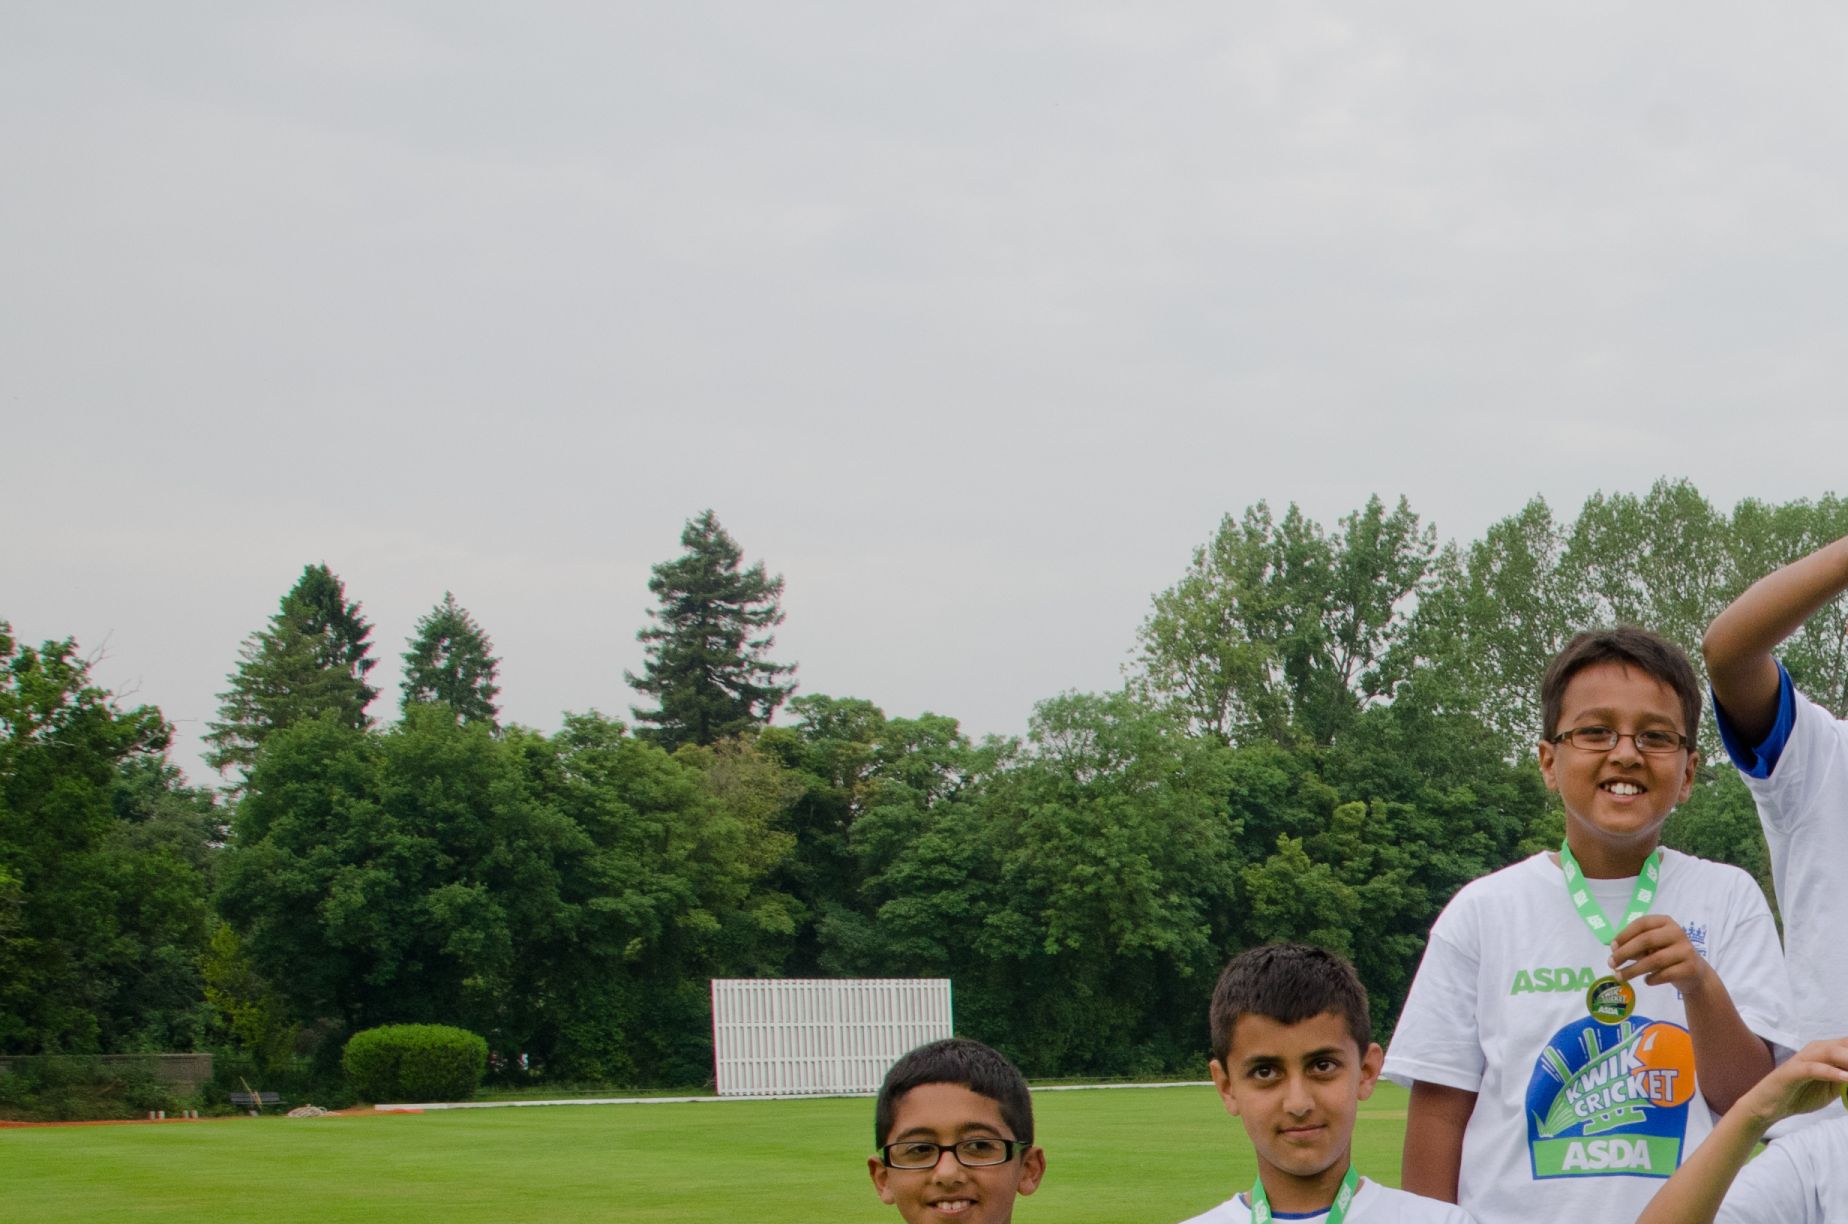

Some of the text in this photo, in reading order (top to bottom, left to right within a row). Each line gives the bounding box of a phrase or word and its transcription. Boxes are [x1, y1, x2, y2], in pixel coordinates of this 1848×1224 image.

[1510, 967, 1596, 995] ASDA
[1566, 1036, 1644, 1104] KWIK
[1575, 1070, 1678, 1116] CRICKET
[1561, 1139, 1651, 1171] ASDA
